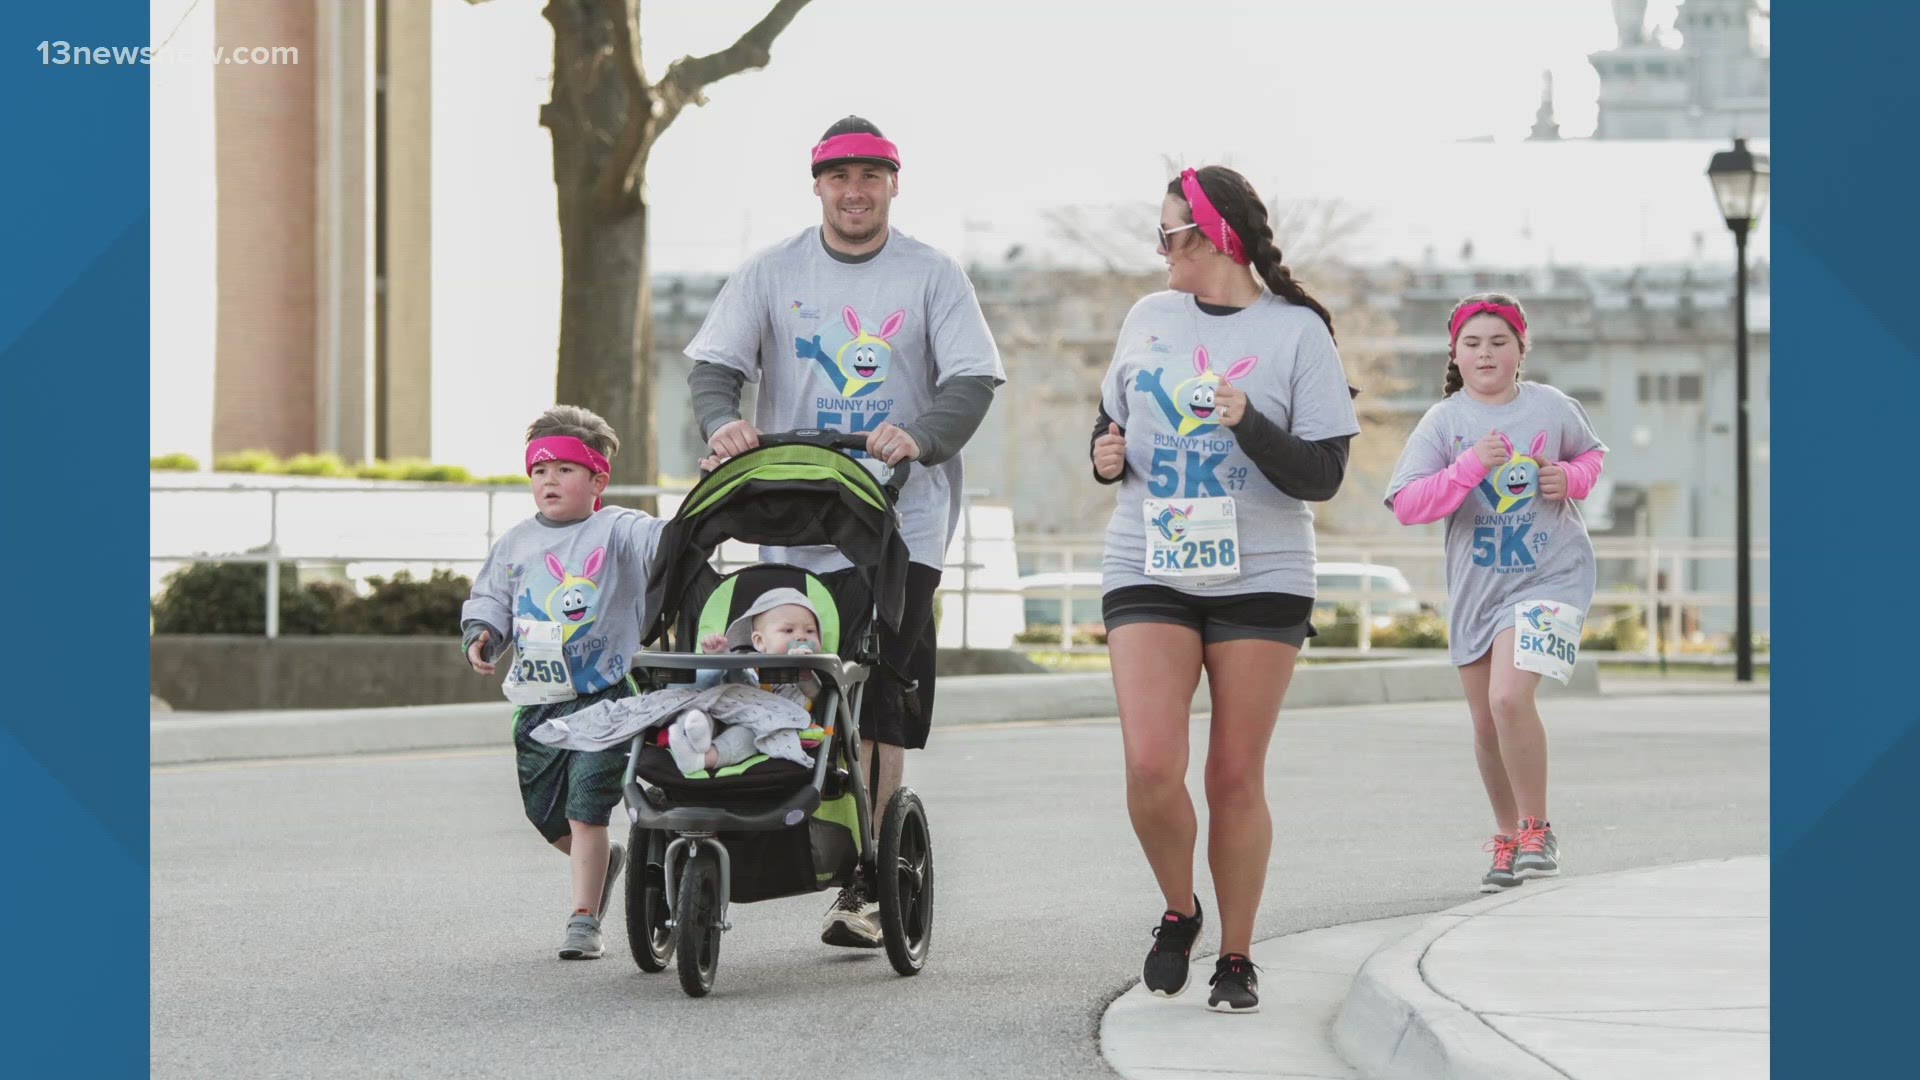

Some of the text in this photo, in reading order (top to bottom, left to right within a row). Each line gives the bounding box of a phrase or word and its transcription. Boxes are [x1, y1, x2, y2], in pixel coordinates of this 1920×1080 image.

[816, 397, 894, 412] BUNNY HOP
[1153, 433, 1234, 452] BUNNY HOP
[1147, 447, 1229, 499] 5K
[1227, 467, 1248, 479] 20
[1227, 479, 1246, 491] 17
[1475, 512, 1537, 526] BUNNY HOP
[1472, 523, 1536, 568] 5K
[1532, 532, 1548, 544] 20
[1151, 538, 1236, 569] 5K 258
[582, 635, 608, 653] HOP
[1520, 633, 1576, 666] 5K 256
[607, 654, 623, 670] 20
[522, 659, 567, 684] 259
[608, 665, 625, 680] 17
